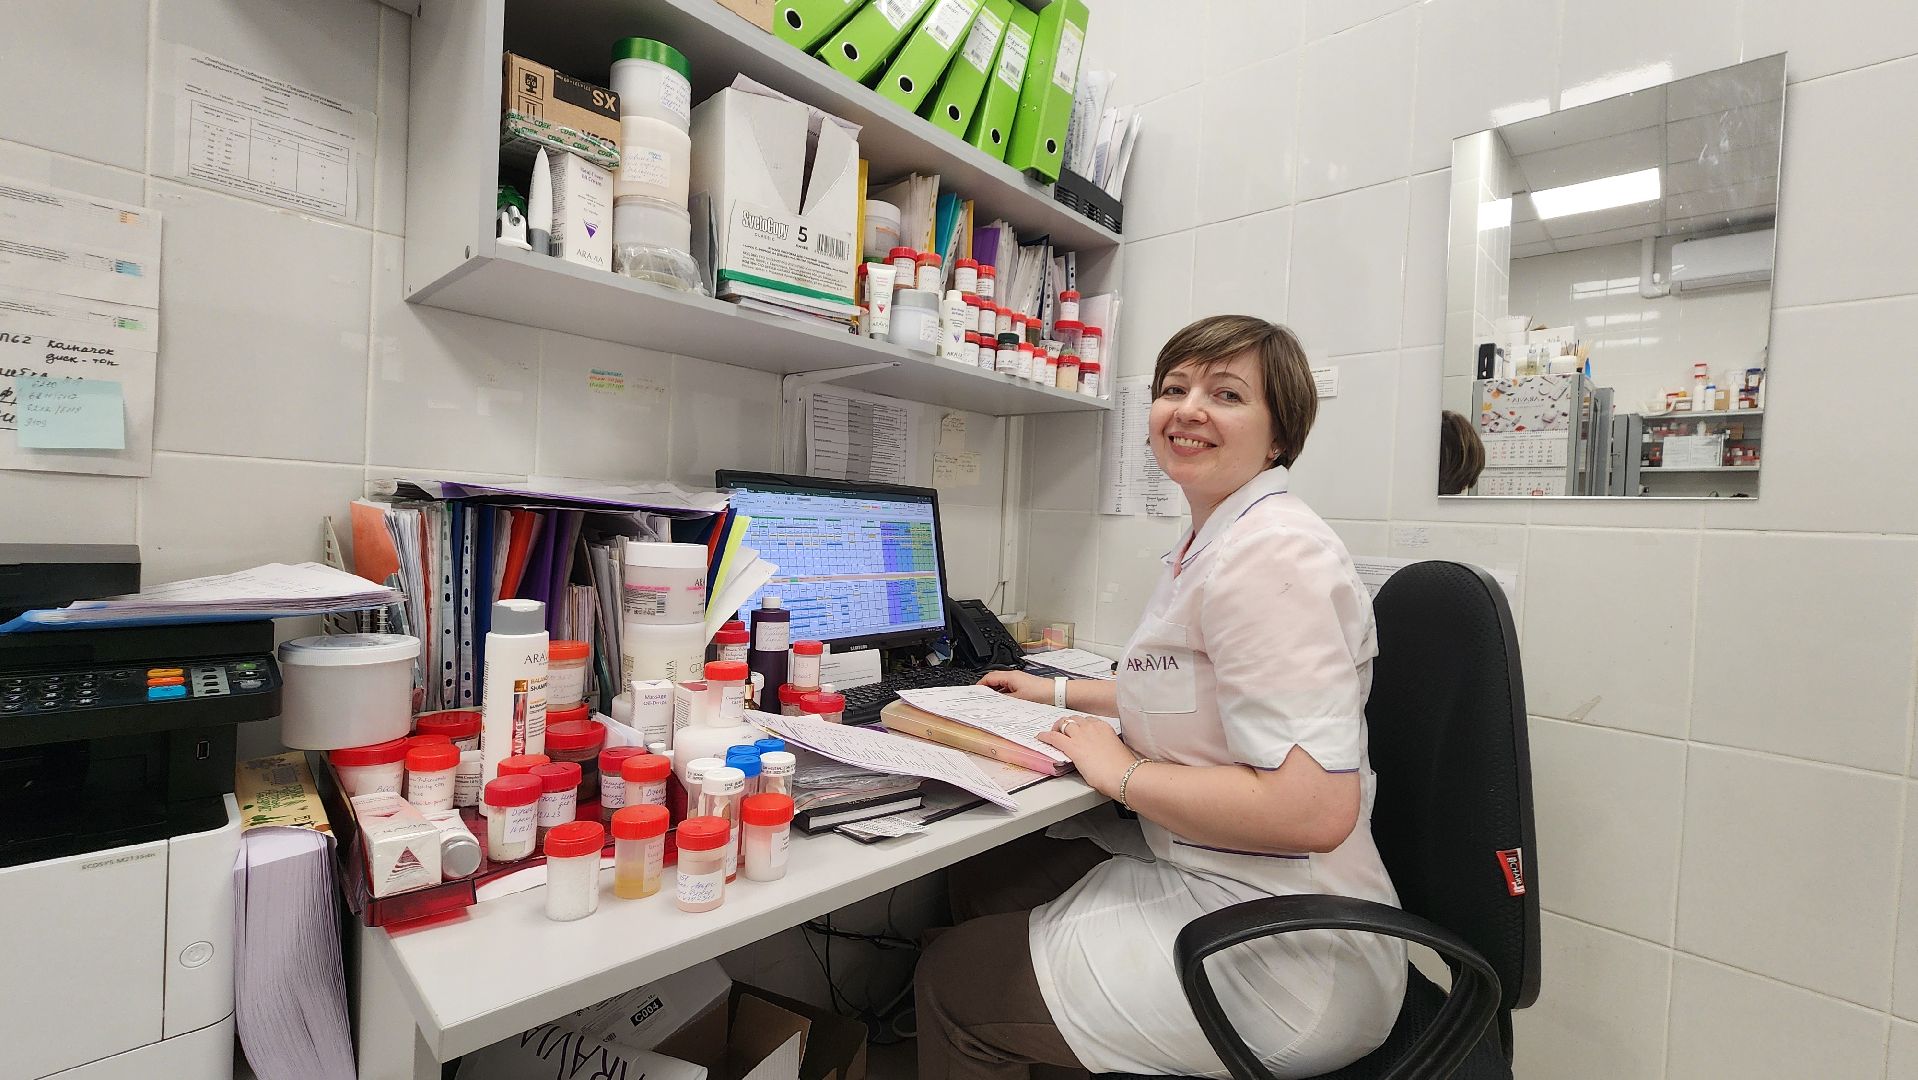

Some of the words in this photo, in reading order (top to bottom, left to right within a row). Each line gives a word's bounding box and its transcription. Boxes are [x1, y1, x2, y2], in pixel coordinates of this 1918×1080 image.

[592, 88, 616, 112] SX
[742, 210, 789, 240] SvetoCopy
[797, 226, 808, 243] 5
[1126, 653, 1180, 672] ARAVIA
[634, 1001, 660, 1023] C004
